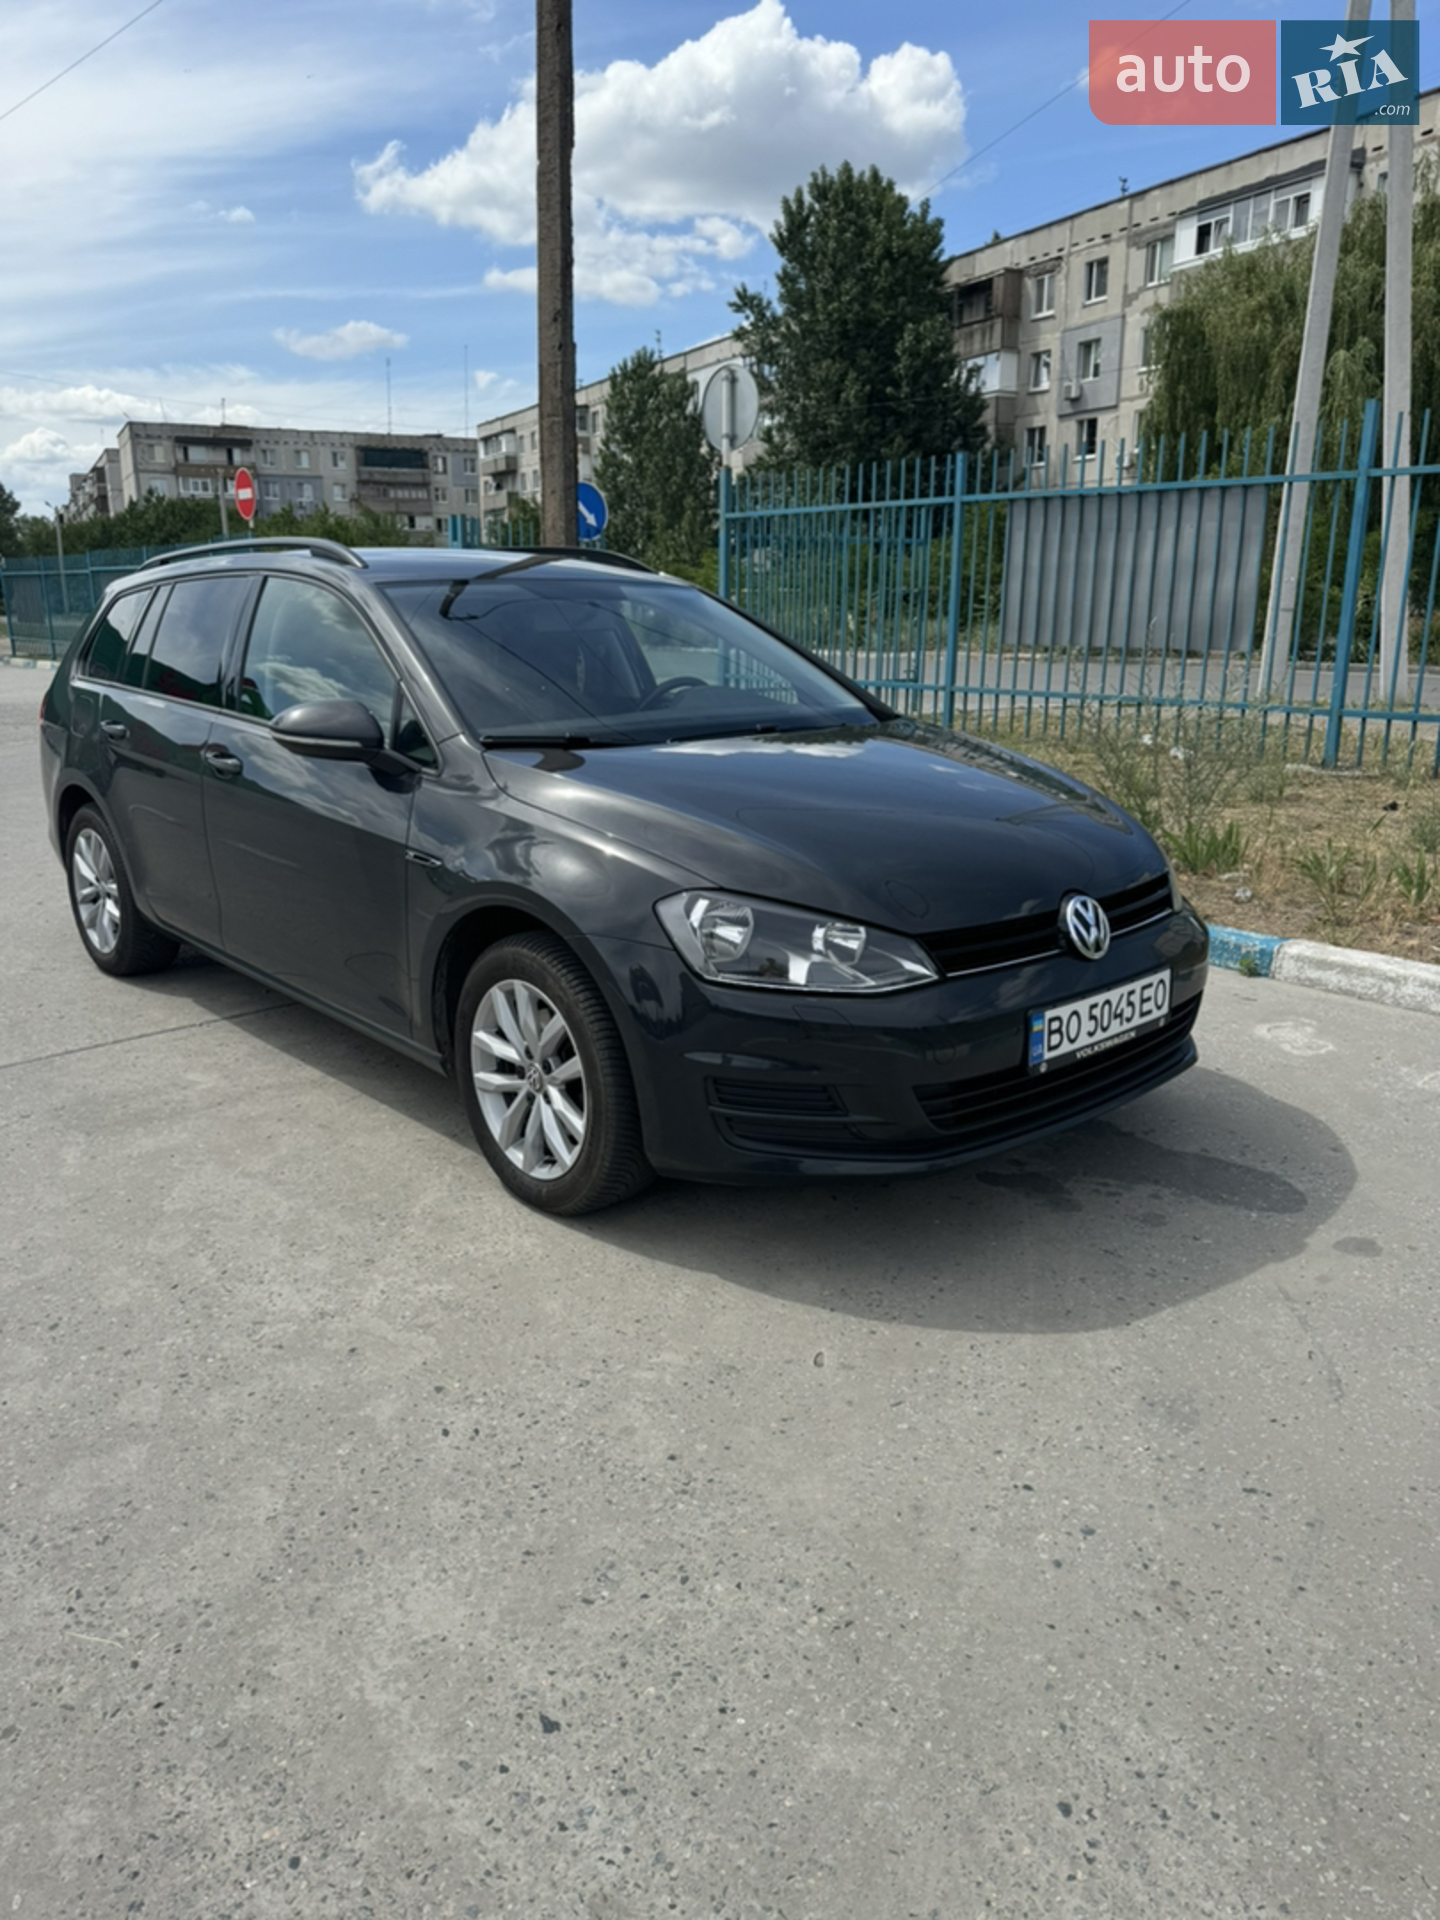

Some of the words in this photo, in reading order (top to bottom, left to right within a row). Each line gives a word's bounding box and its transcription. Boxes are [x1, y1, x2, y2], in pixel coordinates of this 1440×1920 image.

[1046, 1009, 1082, 1052] BO
[1087, 989, 1136, 1038] 5045
[1138, 978, 1167, 1020] EO
